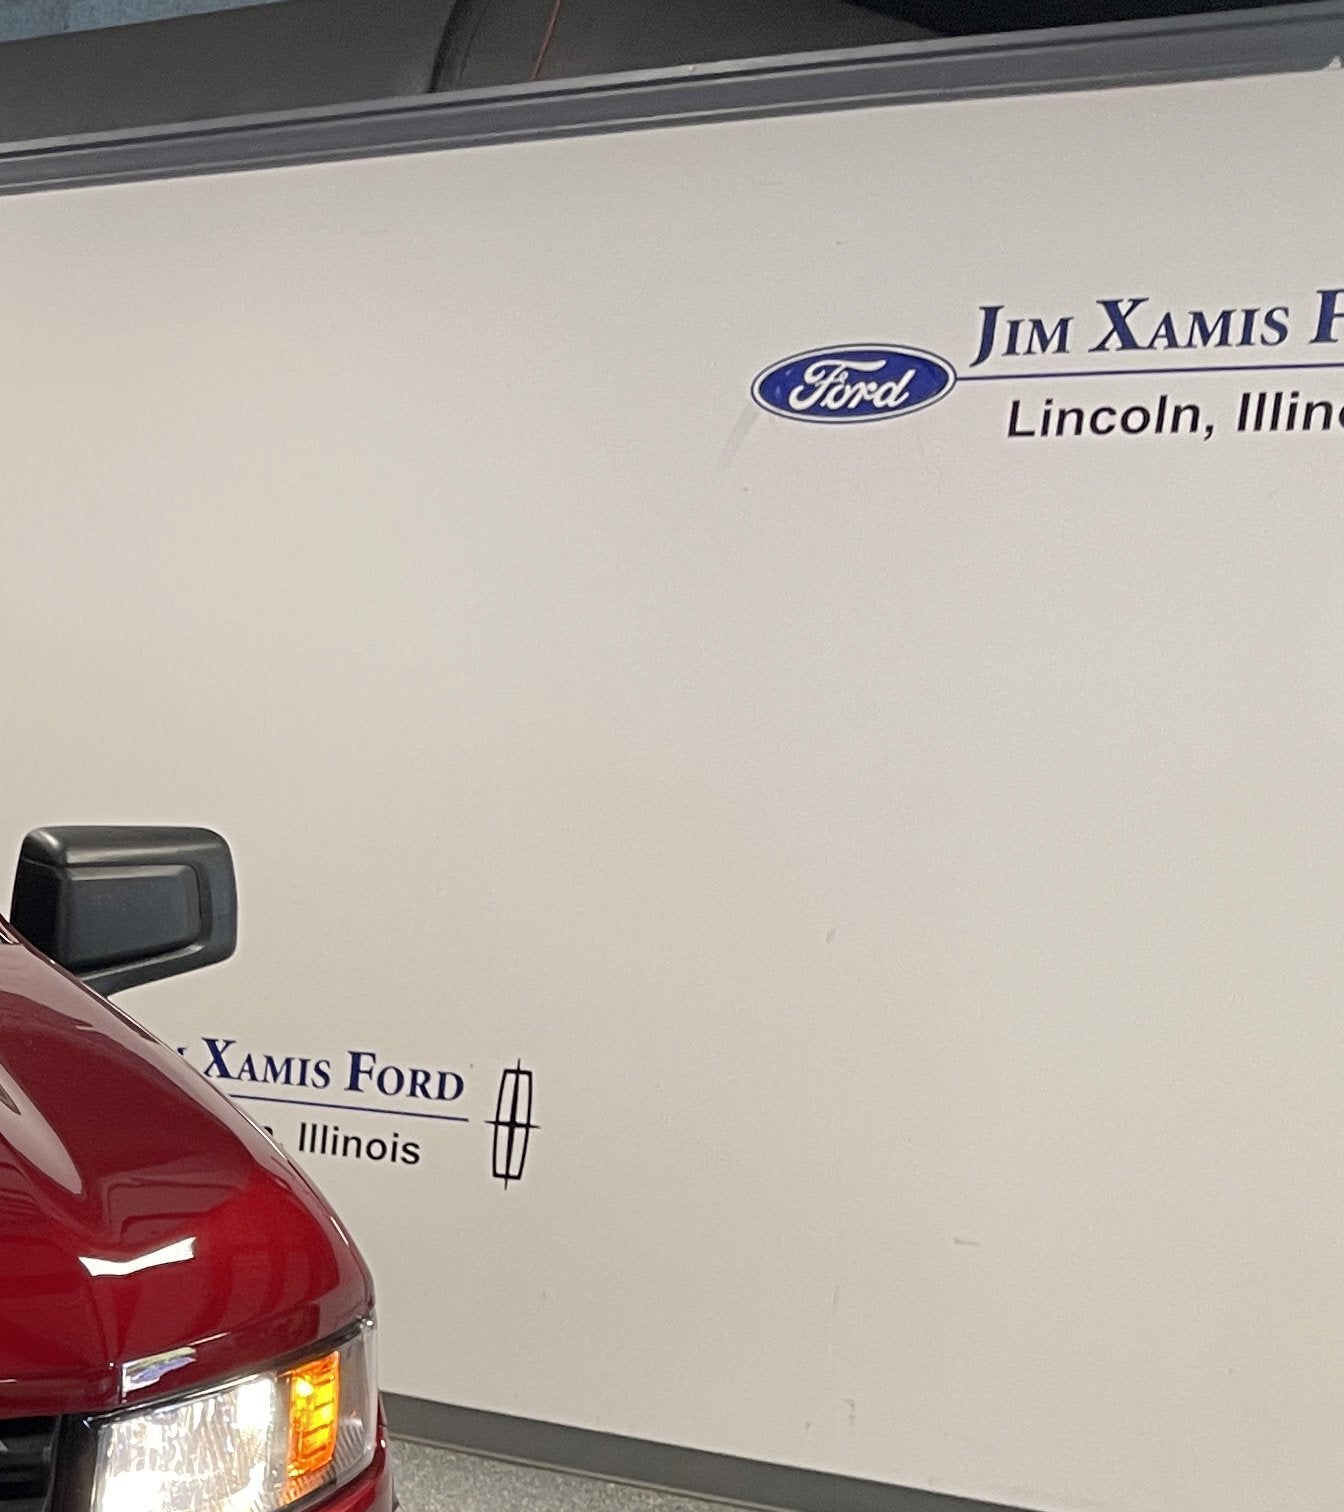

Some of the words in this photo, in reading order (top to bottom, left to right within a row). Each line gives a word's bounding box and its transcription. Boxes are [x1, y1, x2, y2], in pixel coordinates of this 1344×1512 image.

[969, 305, 1073, 368] JIM
[1088, 297, 1289, 353] XAMIS
[788, 359, 916, 411] Ford
[1007, 394, 1214, 441] Lincoln,
[1237, 390, 1344, 432] Illin
[200, 1037, 331, 1090] XAMIS
[345, 1050, 464, 1101] FORD
[299, 1122, 420, 1165] Illinois
